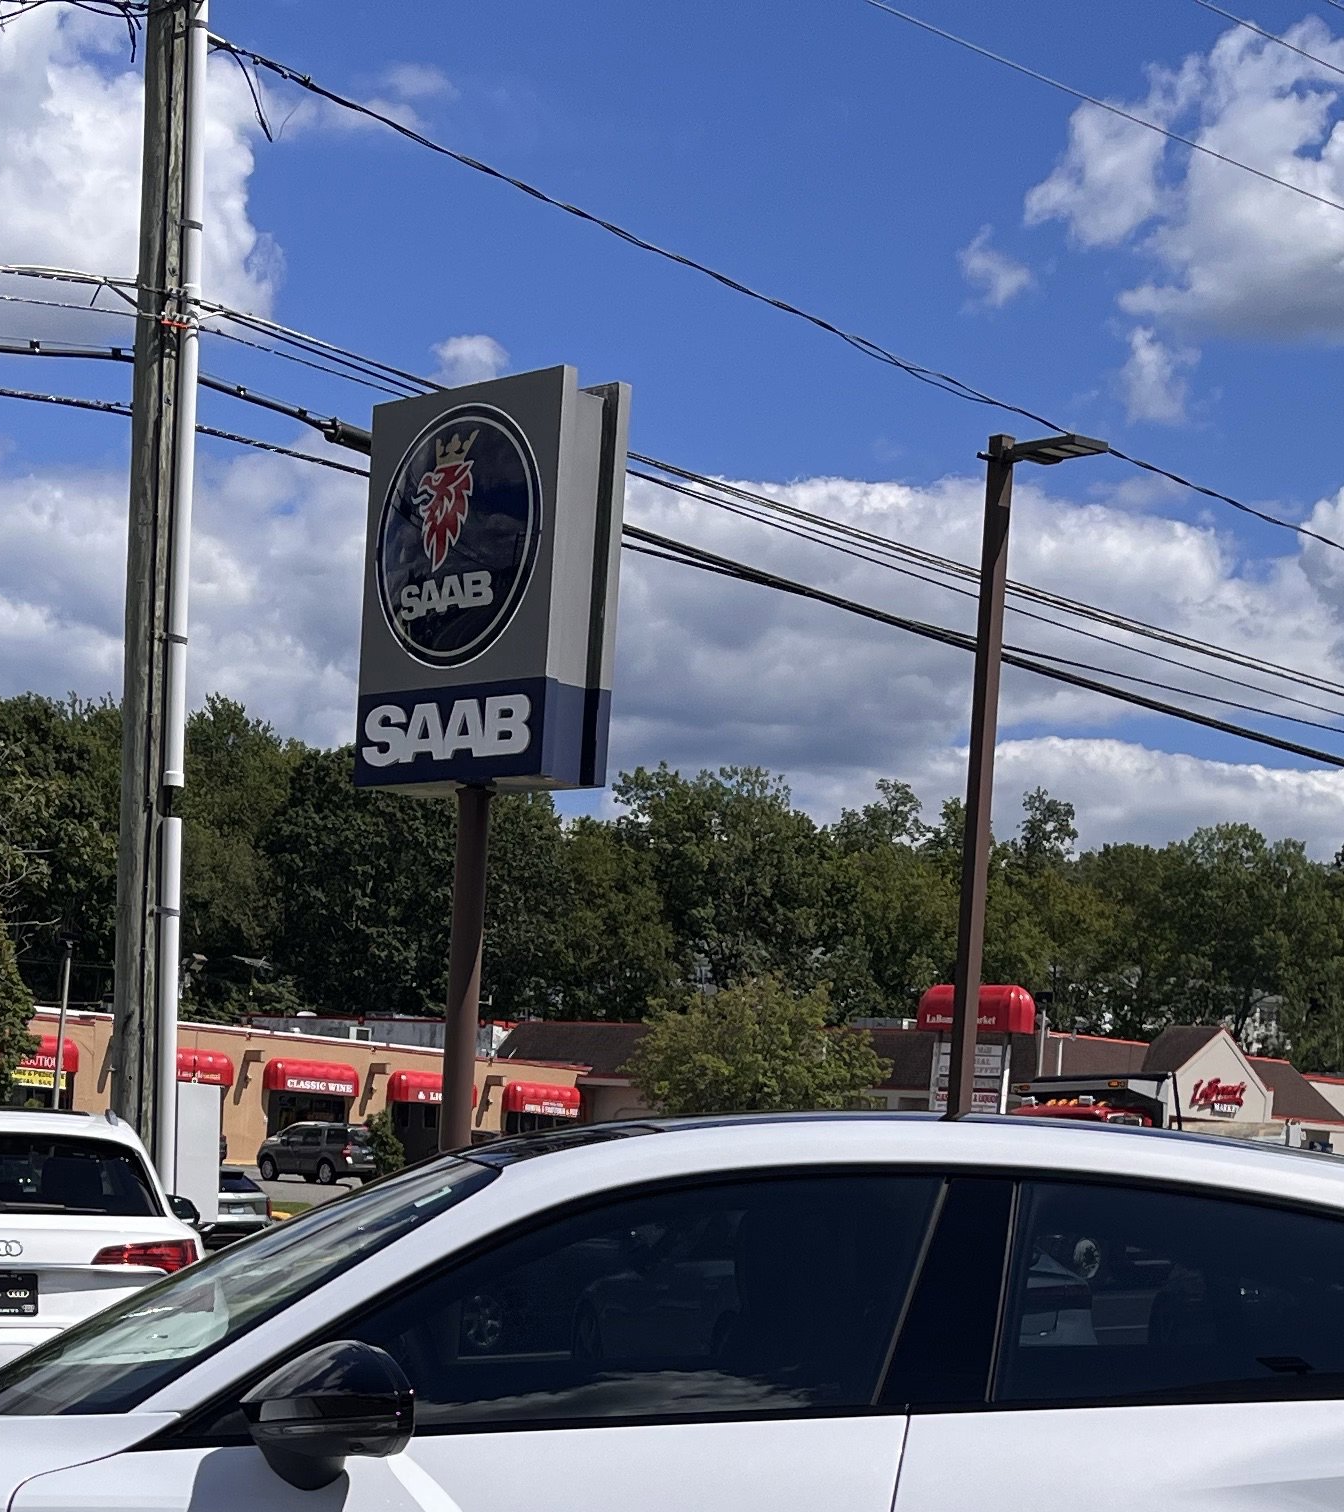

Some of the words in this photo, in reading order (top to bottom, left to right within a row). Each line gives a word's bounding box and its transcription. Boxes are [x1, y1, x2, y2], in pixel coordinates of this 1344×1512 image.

[400, 570, 494, 621] SAAB
[361, 693, 533, 767] SAAB
[286, 1078, 326, 1092] CLASSIC
[328, 1082, 353, 1094] WINE
